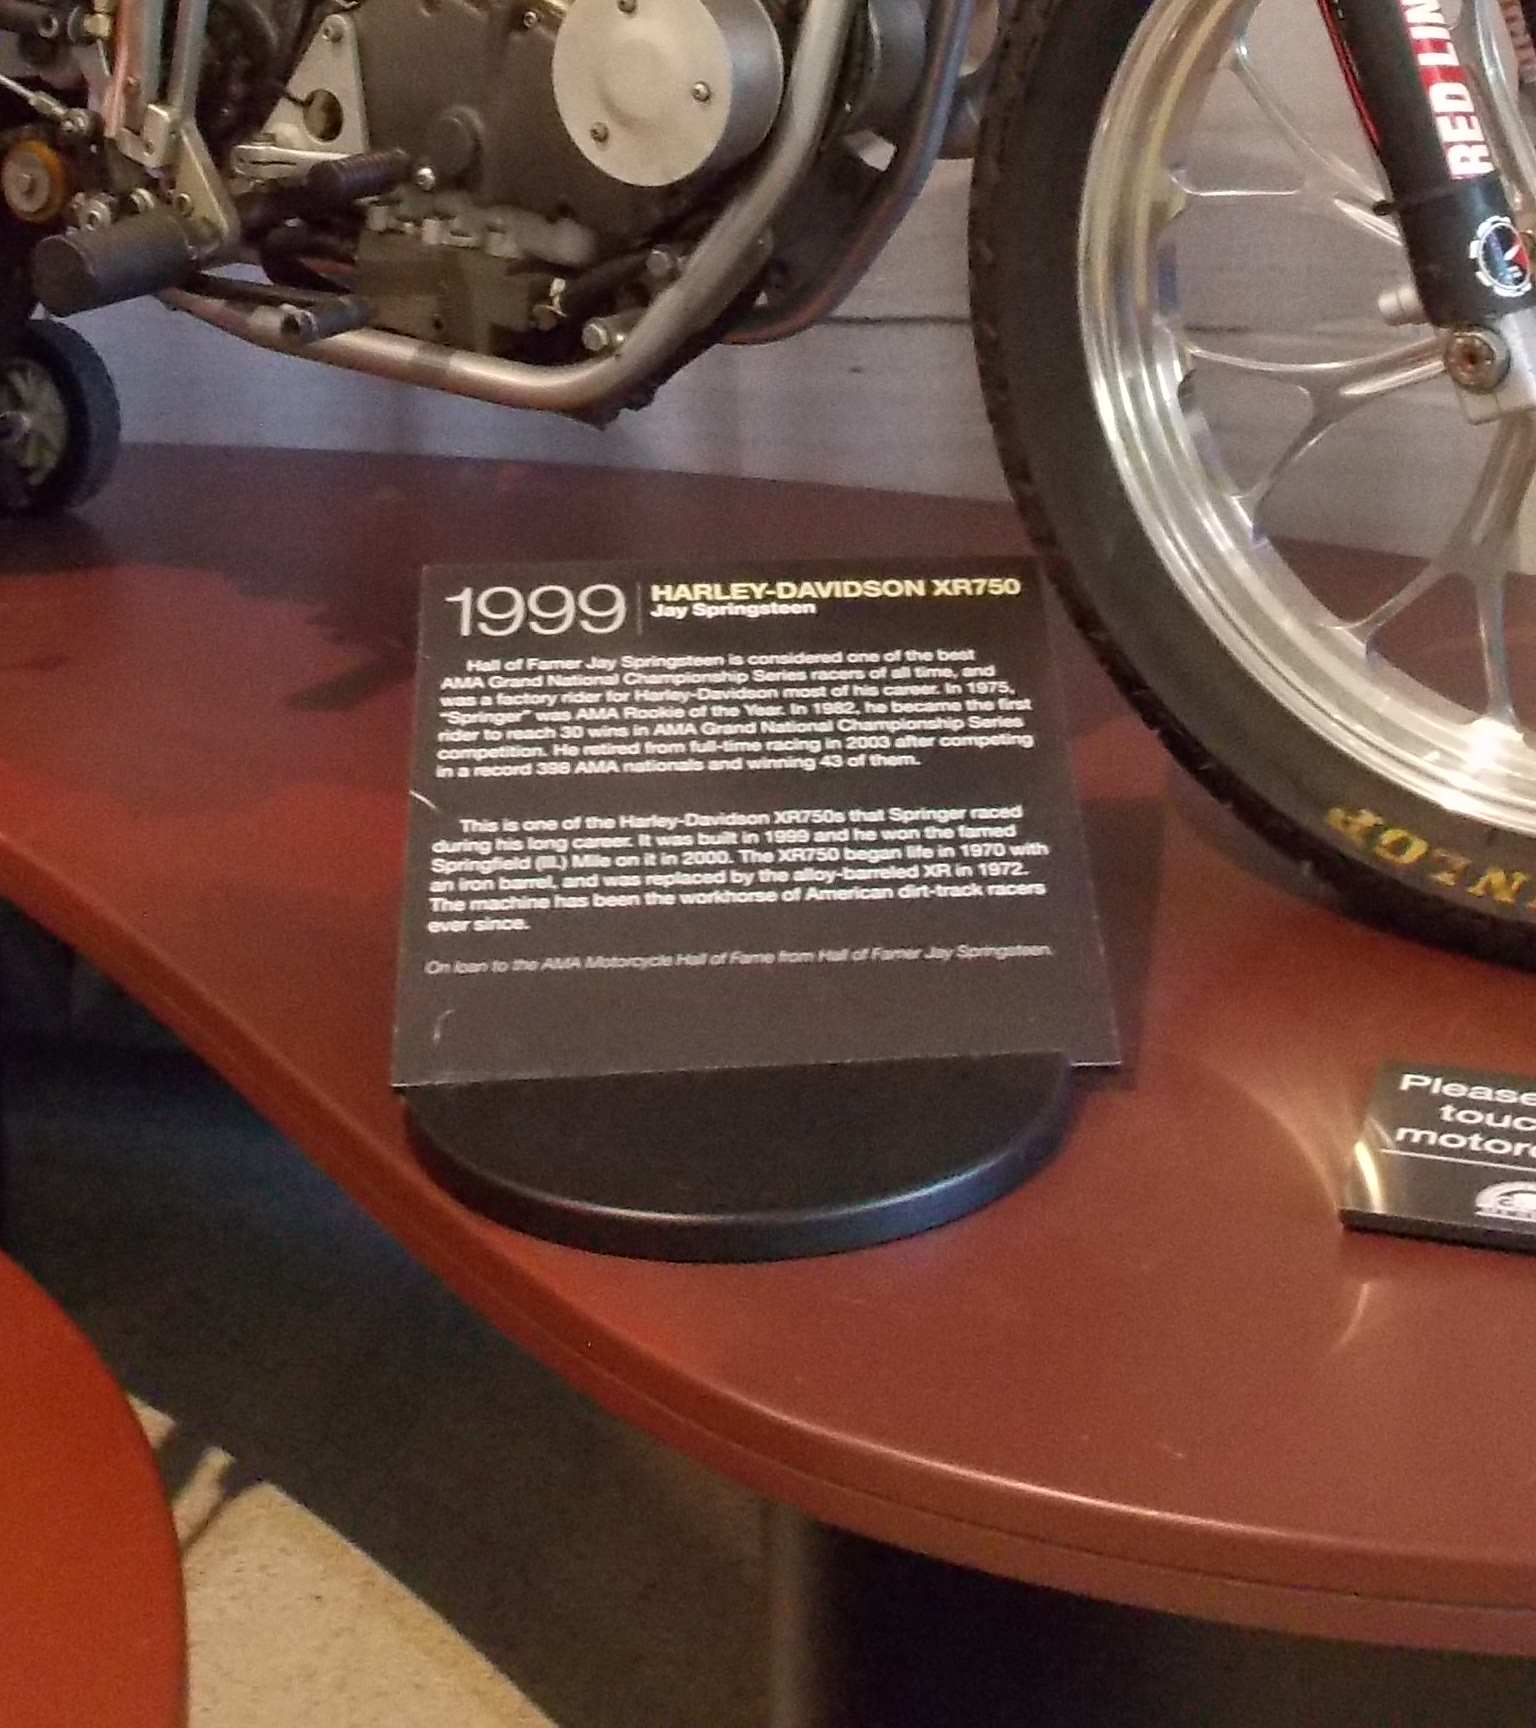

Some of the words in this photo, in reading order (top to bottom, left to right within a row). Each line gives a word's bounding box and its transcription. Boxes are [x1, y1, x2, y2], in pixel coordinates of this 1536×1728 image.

[1427, 79, 1496, 181] RED
[444, 583, 626, 637] 1999
[651, 579, 926, 601] HARLEY-DAVIDSON
[931, 577, 1021, 595] XR750
[650, 603, 688, 619] Jay
[692, 600, 816, 618] Springsteen
[466, 659, 501, 672] Hall
[504, 658, 523, 671] of
[525, 657, 582, 670] Famer
[585, 656, 617, 671] Jay
[620, 654, 725, 670] Springsteen
[728, 653, 744, 665] is
[746, 651, 843, 665] considered
[845, 653, 881, 662] one
[882, 649, 902, 662] of
[903, 649, 934, 661] the
[936, 649, 975, 661] best
[440, 676, 485, 689] AMA
[487, 675, 543, 688] Grand
[546, 673, 619, 686] National
[622, 670, 749, 686] Championship
[751, 668, 807, 681] Series
[809, 669, 866, 680] racers
[867, 666, 888, 679] of
[890, 666, 912, 678] all
[912, 665, 958, 678] time,
[960, 665, 996, 677] and
[439, 696, 477, 706] was
[480, 696, 493, 705] a
[495, 691, 557, 707] factory
[560, 691, 602, 703] rider
[605, 689, 630, 702] for
[634, 686, 780, 702] Harley-Davidson
[781, 686, 827, 698] most
[829, 684, 850, 696] of
[851, 684, 879, 696] his
[881, 684, 940, 696] career.
[943, 682, 962, 694] In
[966, 681, 1015, 694] 1975,
[535, 711, 572, 721] was
[575, 707, 619, 720] AMA
[622, 705, 685, 719] Rookie
[688, 705, 707, 717] of
[710, 705, 740, 717] the
[743, 703, 785, 716] Year.
[789, 703, 808, 714] In
[863, 701, 888, 713] he
[889, 700, 962, 713] became
[964, 698, 996, 711] the
[996, 697, 1032, 710] first
[437, 729, 480, 741] rider
[483, 729, 503, 740] to
[505, 726, 557, 739] reach
[559, 725, 584, 738] 30
[586, 725, 629, 737] wins
[632, 724, 649, 736] in
[652, 722, 698, 735] AMA
[700, 721, 757, 735] Grand
[760, 719, 834, 733] National
[836, 716, 966, 733] Championship
[966, 715, 1024, 728] Series
[436, 745, 547, 761] competition.
[552, 743, 579, 756] He
[582, 742, 641, 755] retired
[644, 740, 686, 754] from
[689, 739, 762, 753] full-time
[764, 738, 822, 753] racing
[824, 737, 842, 749] in
[844, 735, 892, 749] 2003
[893, 734, 936, 747] after
[937, 733, 1034, 749] competing
[436, 765, 454, 777] in
[457, 767, 470, 777] a
[473, 763, 532, 776] record
[574, 760, 619, 773] AMA
[622, 758, 704, 772] nationals
[707, 757, 743, 770] and
[745, 755, 816, 772] winning
[818, 754, 844, 767] 43
[845, 753, 867, 766] of
[868, 753, 920, 766] them.
